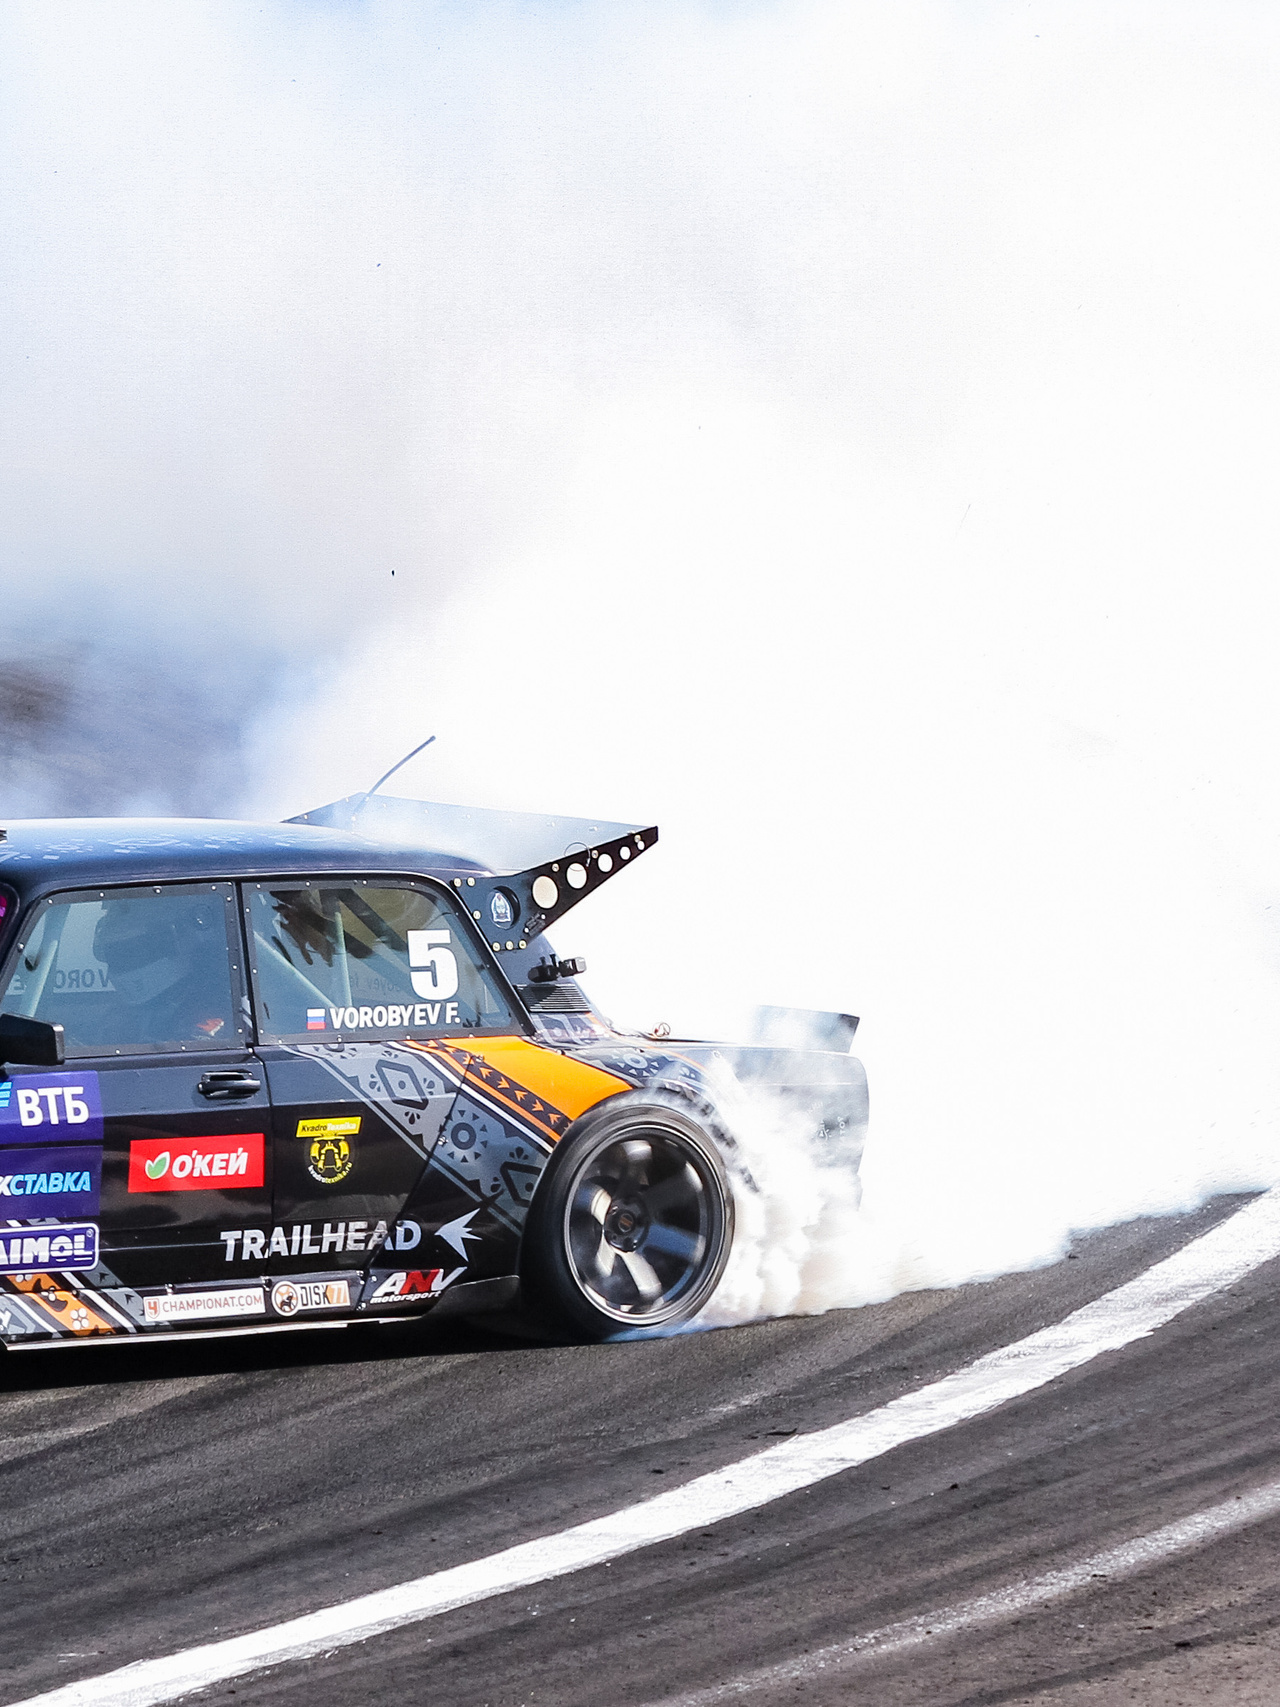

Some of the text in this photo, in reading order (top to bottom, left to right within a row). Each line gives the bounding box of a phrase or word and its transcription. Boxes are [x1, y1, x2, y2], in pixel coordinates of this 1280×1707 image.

[407, 929, 459, 1000] 5
[329, 1002, 461, 1029] VOROBYEV F.
[16, 1086, 89, 1127] ВТБ
[220, 1219, 422, 1261] TRAILHEAD
[162, 1295, 263, 1312] CHAMPIONAT.COM
[370, 1290, 441, 1304] motorsport
